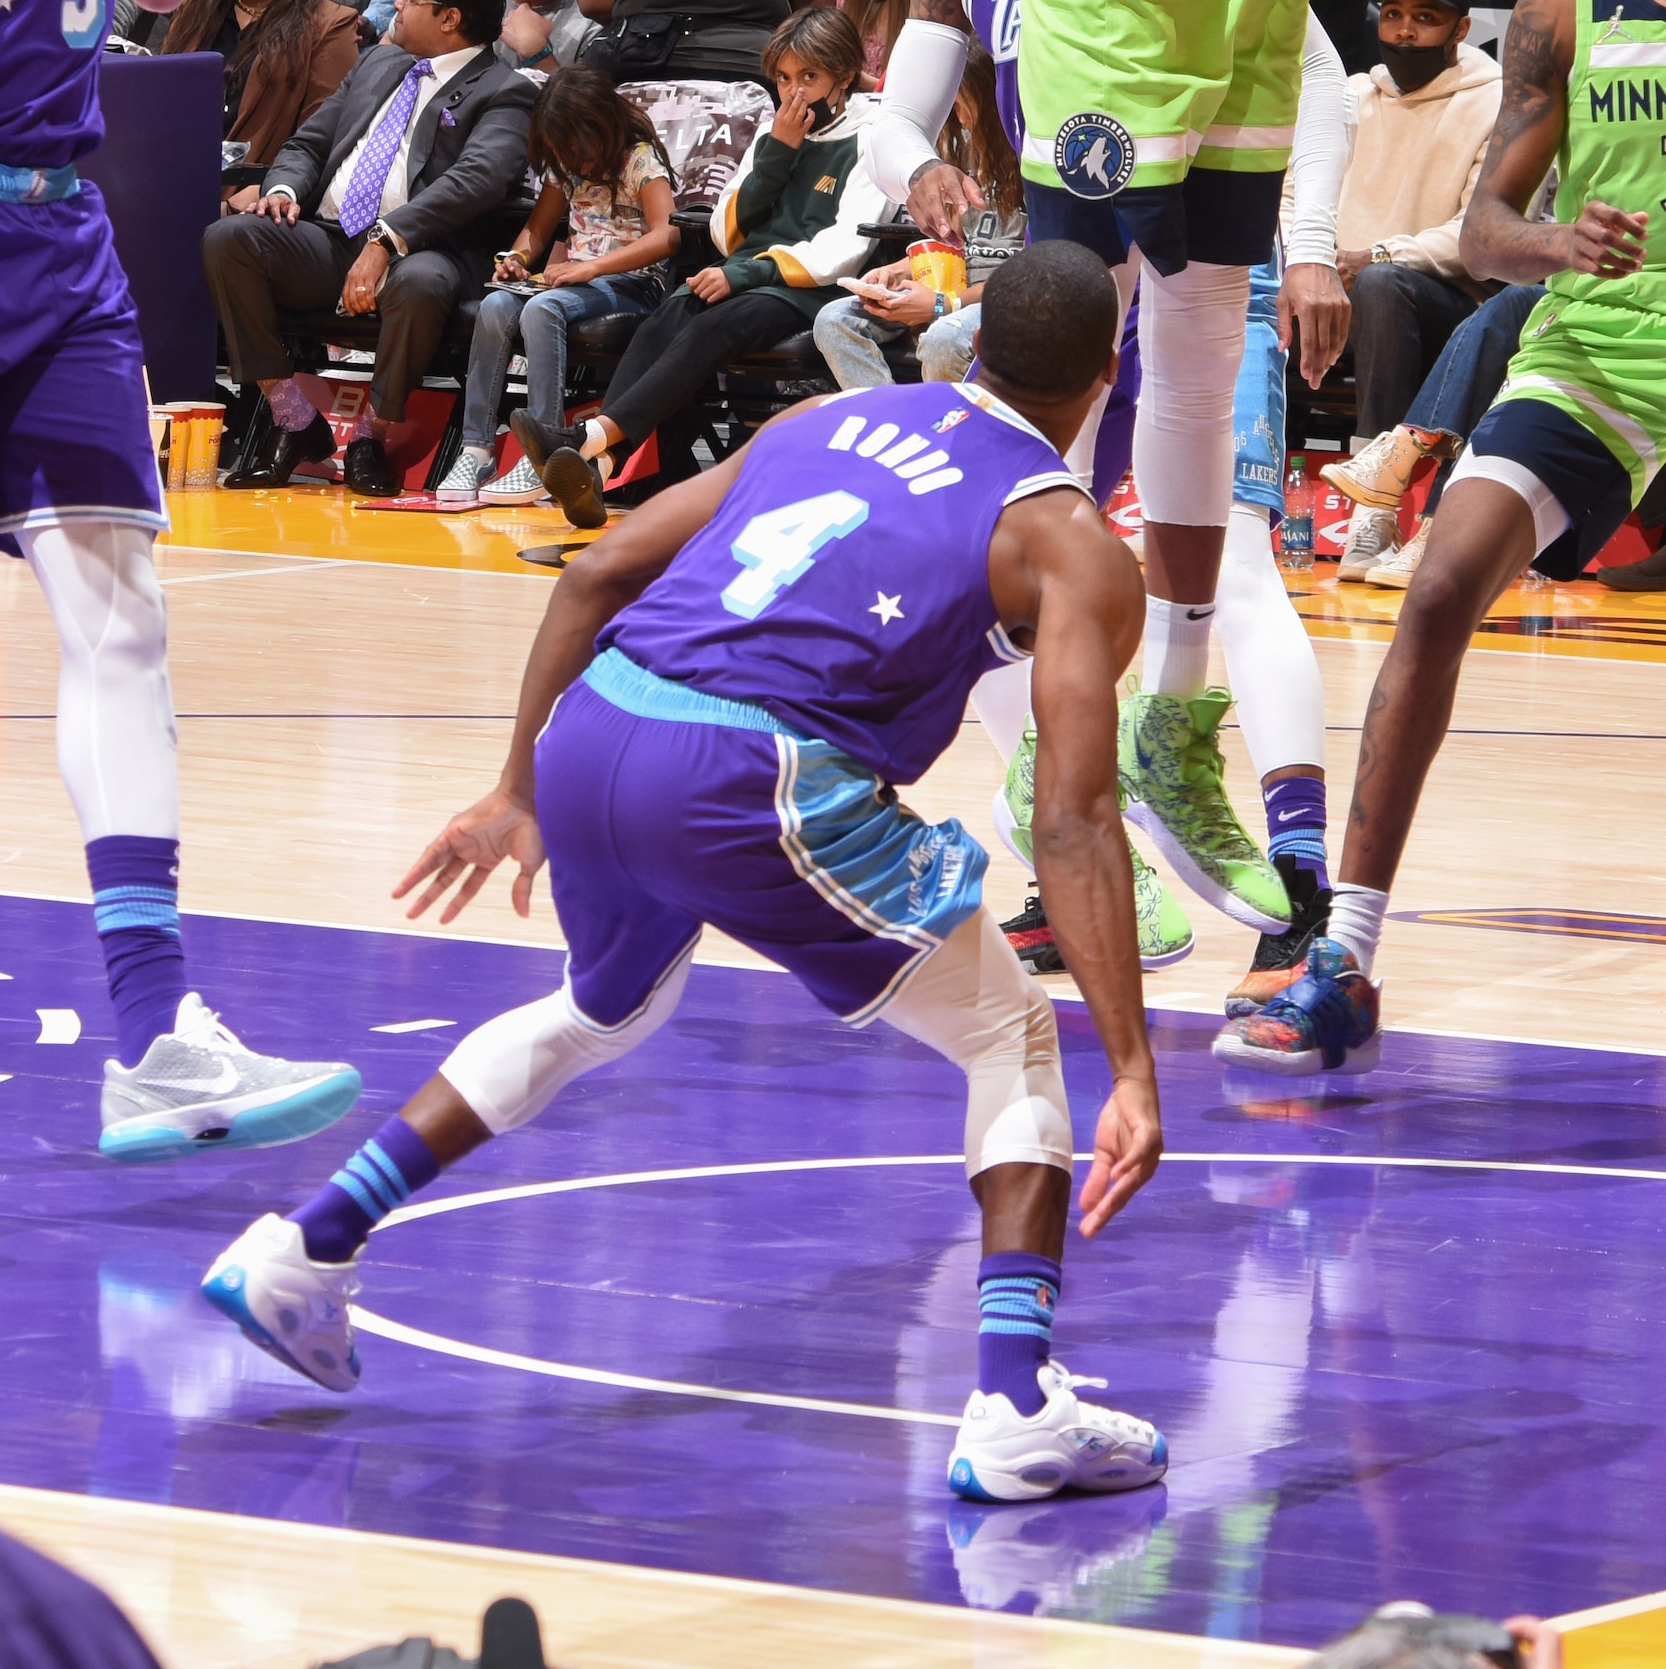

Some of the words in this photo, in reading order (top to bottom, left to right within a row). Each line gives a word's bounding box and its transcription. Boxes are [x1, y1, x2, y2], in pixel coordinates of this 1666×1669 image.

[1055, 115, 1086, 167] MINNESOTA
[1090, 114, 1133, 184] TIMBERWOLVES
[829, 416, 963, 496] RONDO
[1242, 462, 1278, 485] LAKERS
[720, 489, 870, 620] 4
